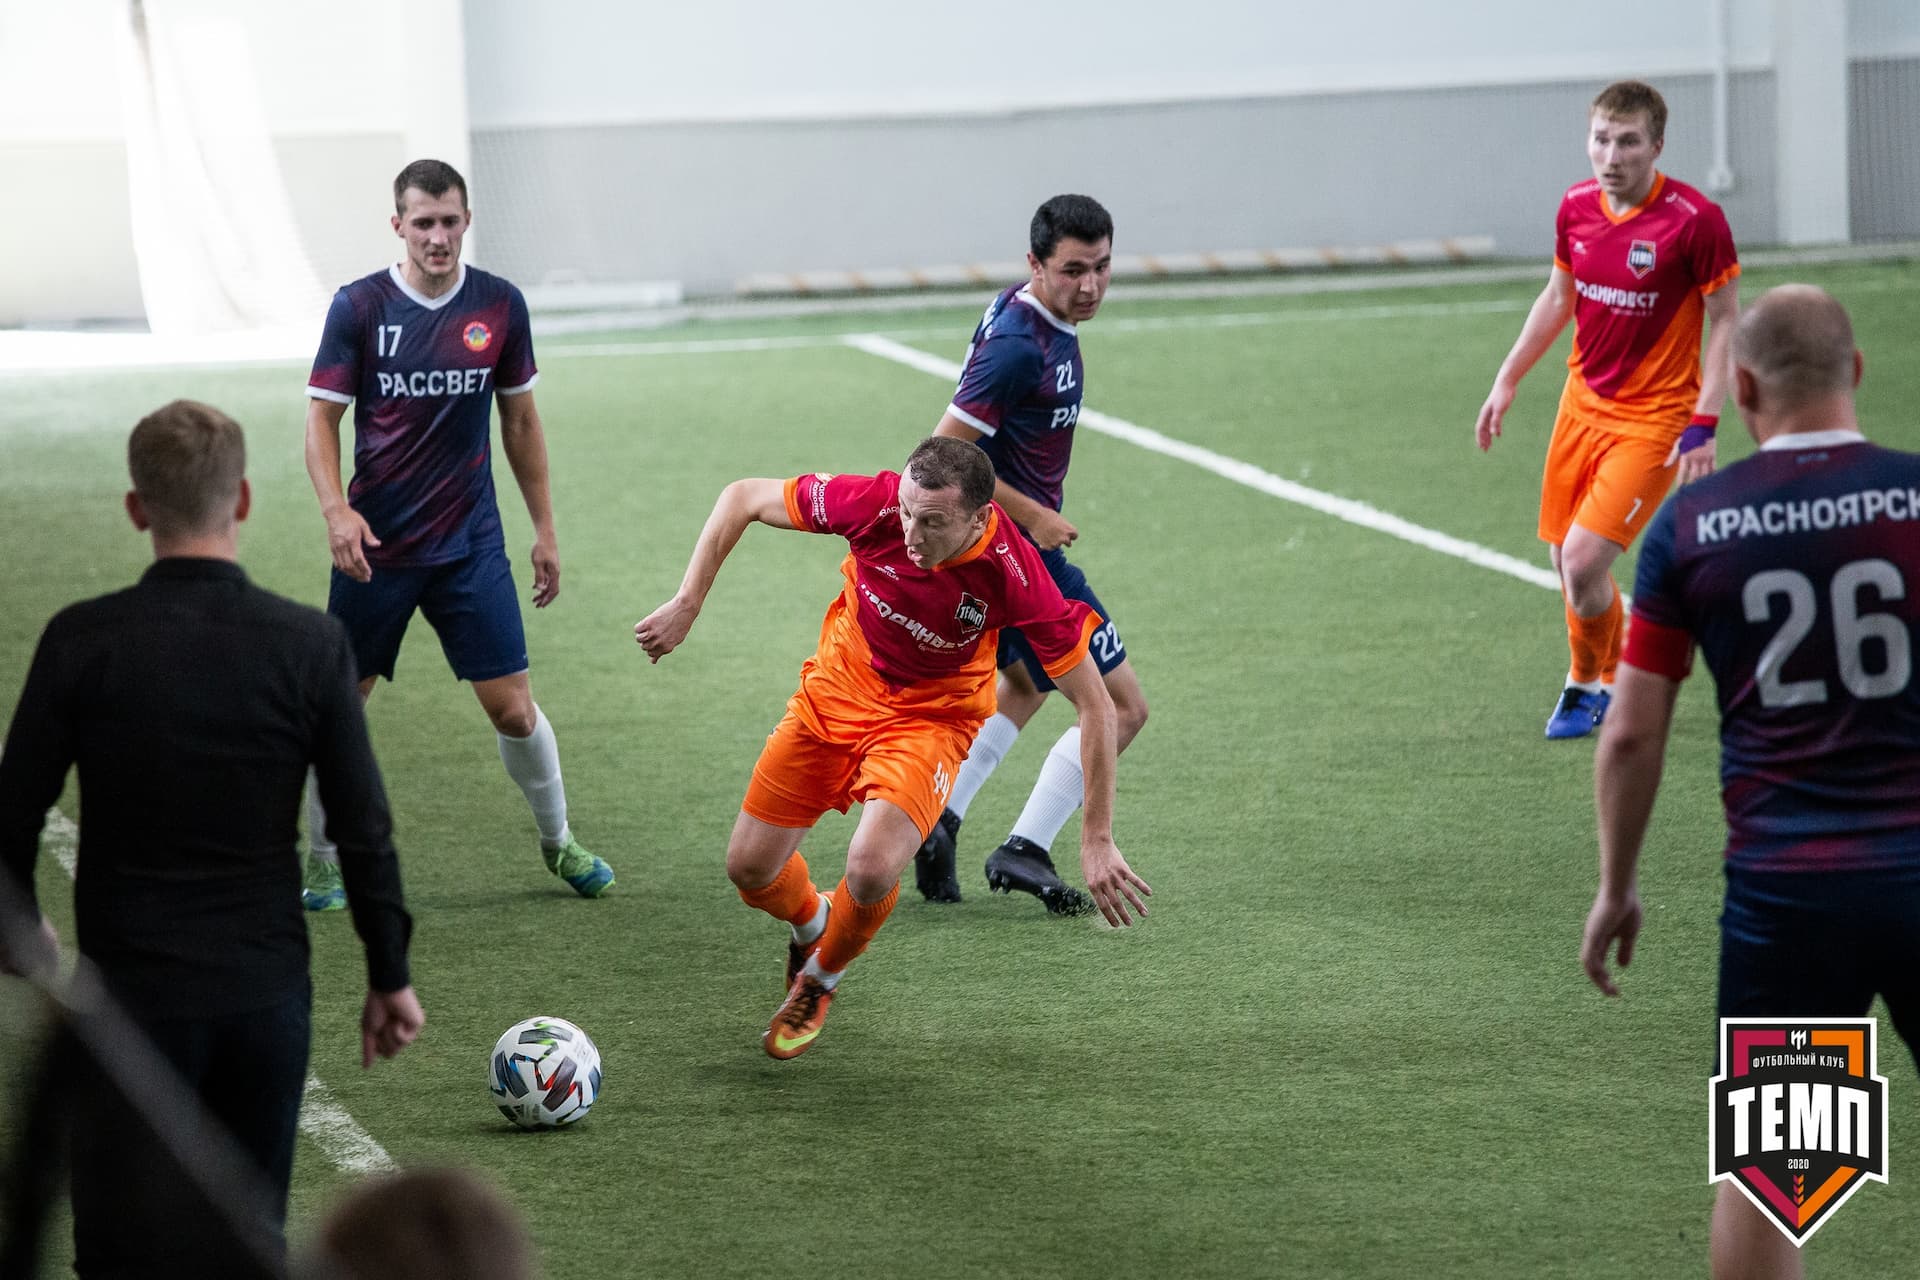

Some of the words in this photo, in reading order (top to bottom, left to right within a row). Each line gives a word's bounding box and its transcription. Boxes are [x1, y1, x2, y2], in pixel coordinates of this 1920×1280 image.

[378, 324, 402, 357] 17
[377, 367, 491, 398] РАССВЕТ
[1056, 359, 1076, 393] 22
[1050, 398, 1082, 429] РА
[1092, 620, 1123, 663] 22
[1742, 558, 1912, 708] 26
